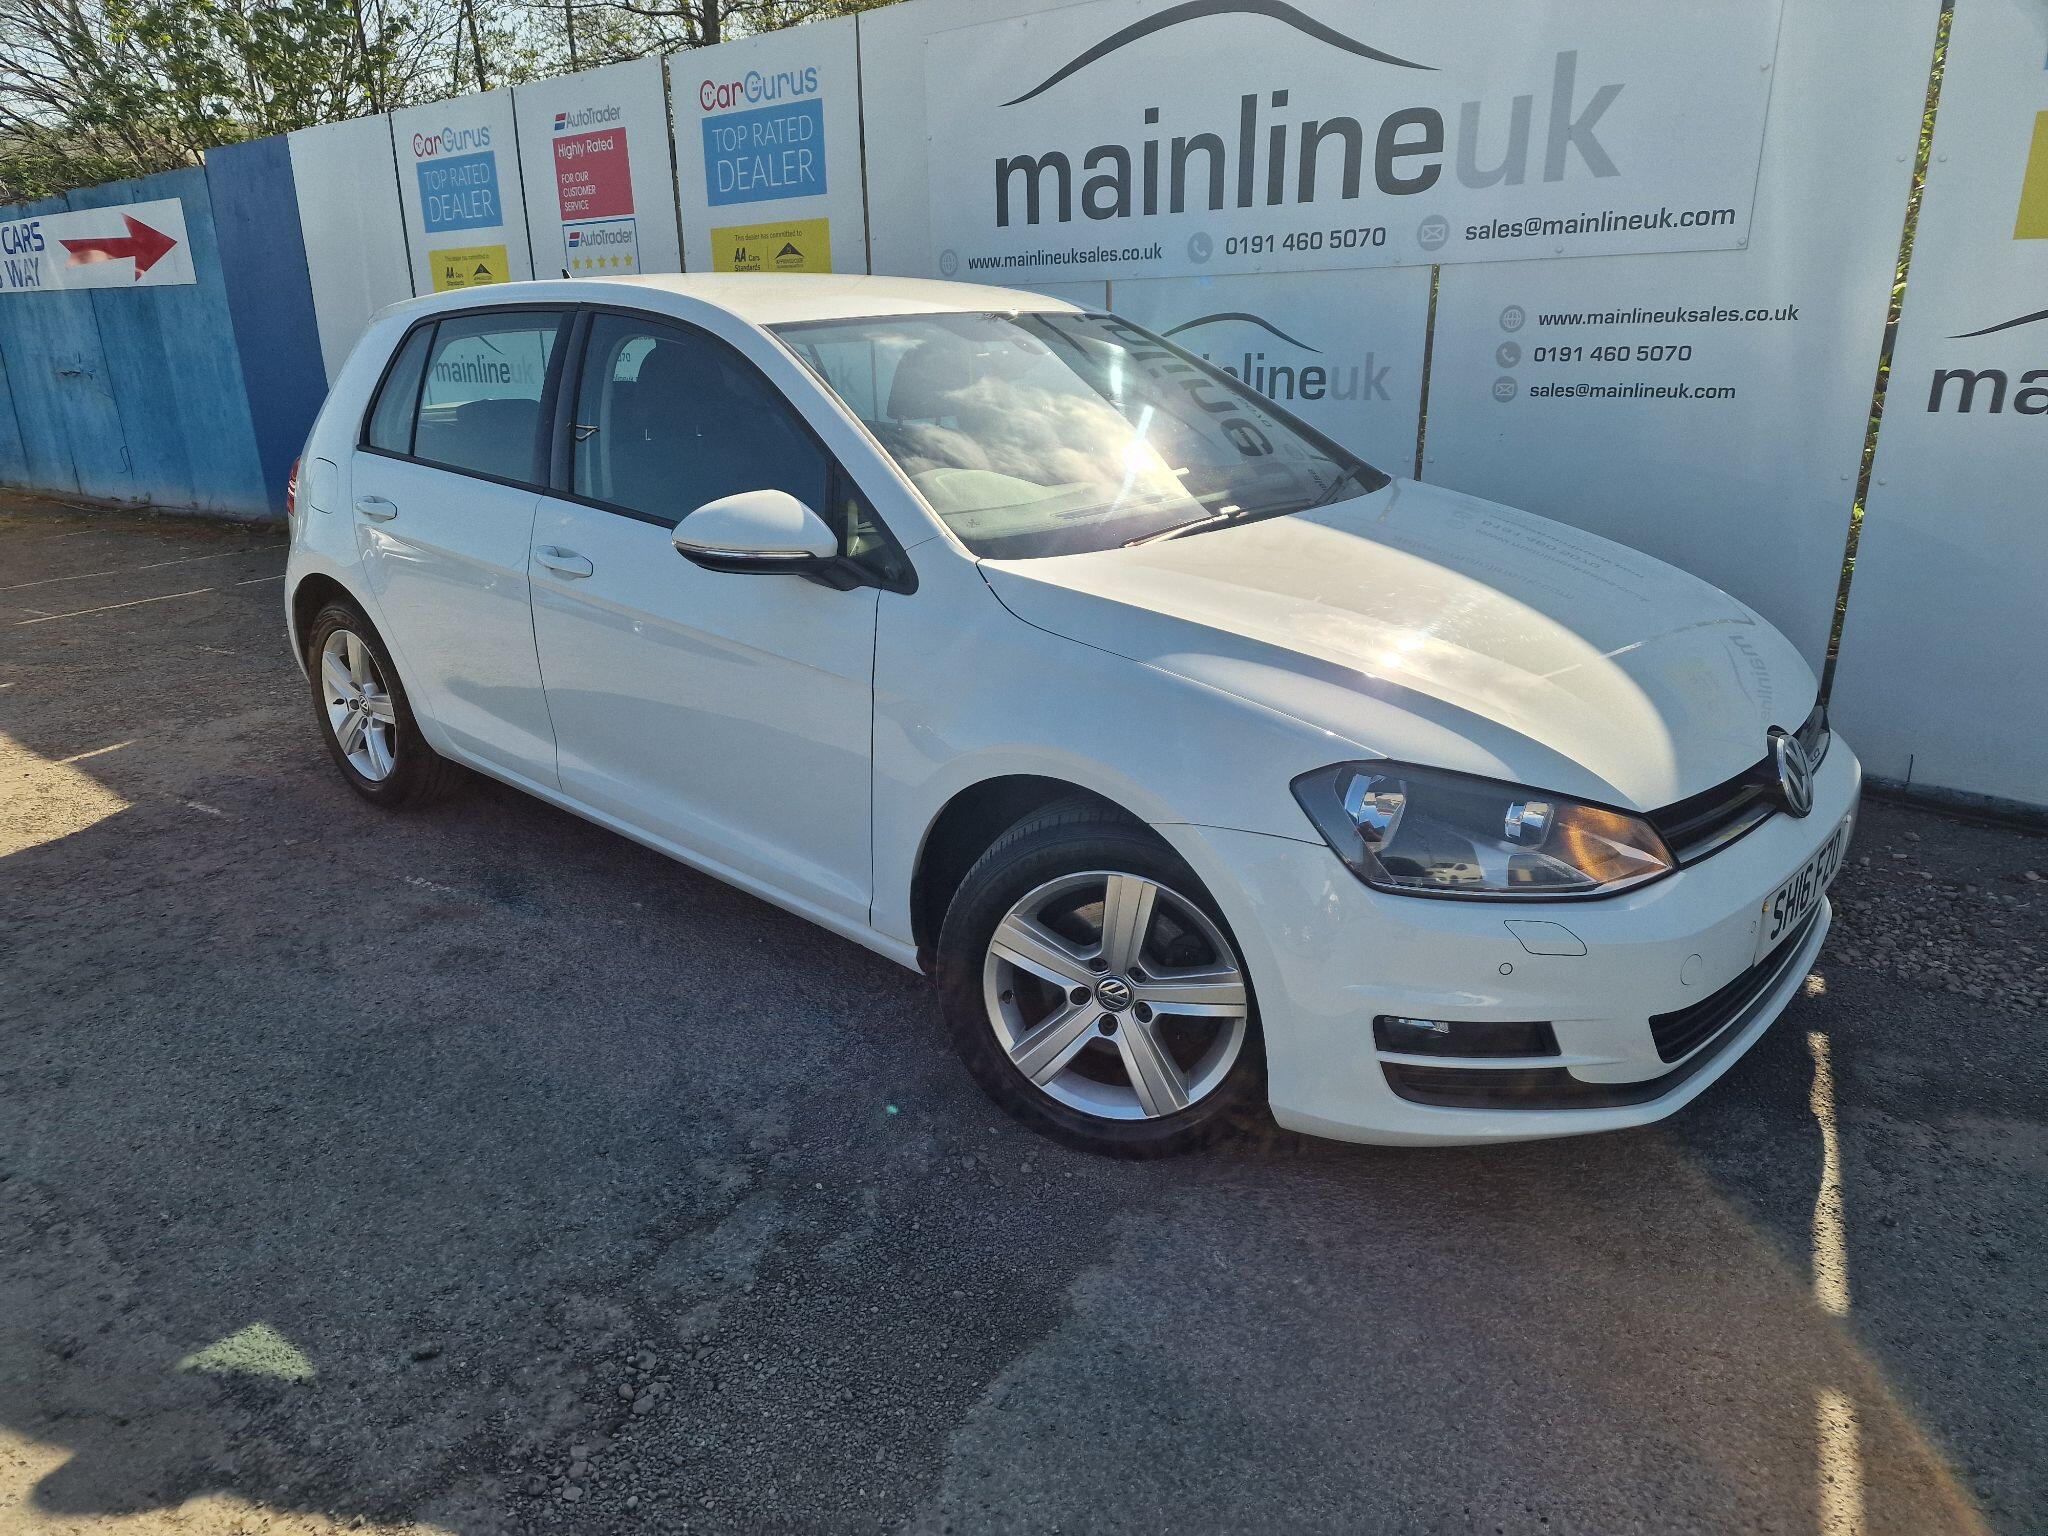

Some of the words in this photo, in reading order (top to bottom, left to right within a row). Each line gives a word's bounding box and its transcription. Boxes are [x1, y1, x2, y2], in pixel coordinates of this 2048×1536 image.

[700, 66, 818, 111] CarGurus
[566, 105, 621, 129] AutoTrader
[413, 126, 491, 157] CarGurus
[712, 125, 748, 152] TOP
[753, 115, 813, 148] RATED
[558, 141, 585, 159] Highly
[587, 136, 613, 153] Rated
[424, 168, 448, 191] TOP
[451, 163, 490, 185] RATED
[561, 173, 574, 184] FOR
[575, 171, 589, 182] OUR
[717, 149, 815, 192] DEALER
[563, 185, 596, 197] CUSTOMER
[428, 190, 495, 223] DEALER
[564, 199, 590, 211] SERVICE
[1, 221, 45, 255] CARS
[580, 229, 632, 247] AutoTrader
[967, 242, 1163, 271] www.mainlineuksales.co.uk
[1225, 234, 1275, 256] 0191
[1282, 230, 1323, 252] 460
[1329, 226, 1388, 250] 5070
[1465, 206, 1736, 242] sales@mainlineuk.com
[734, 247, 747, 262] AA
[4, 257, 41, 288] WAY
[1538, 304, 1800, 326] www.mainlineuksales.co.uk
[1533, 346, 1583, 362] 0191
[1590, 345, 1631, 362] 460
[1636, 345, 1692, 361] 5070
[1530, 382, 1736, 399] sales@mainlineuk.com
[1770, 863, 1814, 940] SH16
